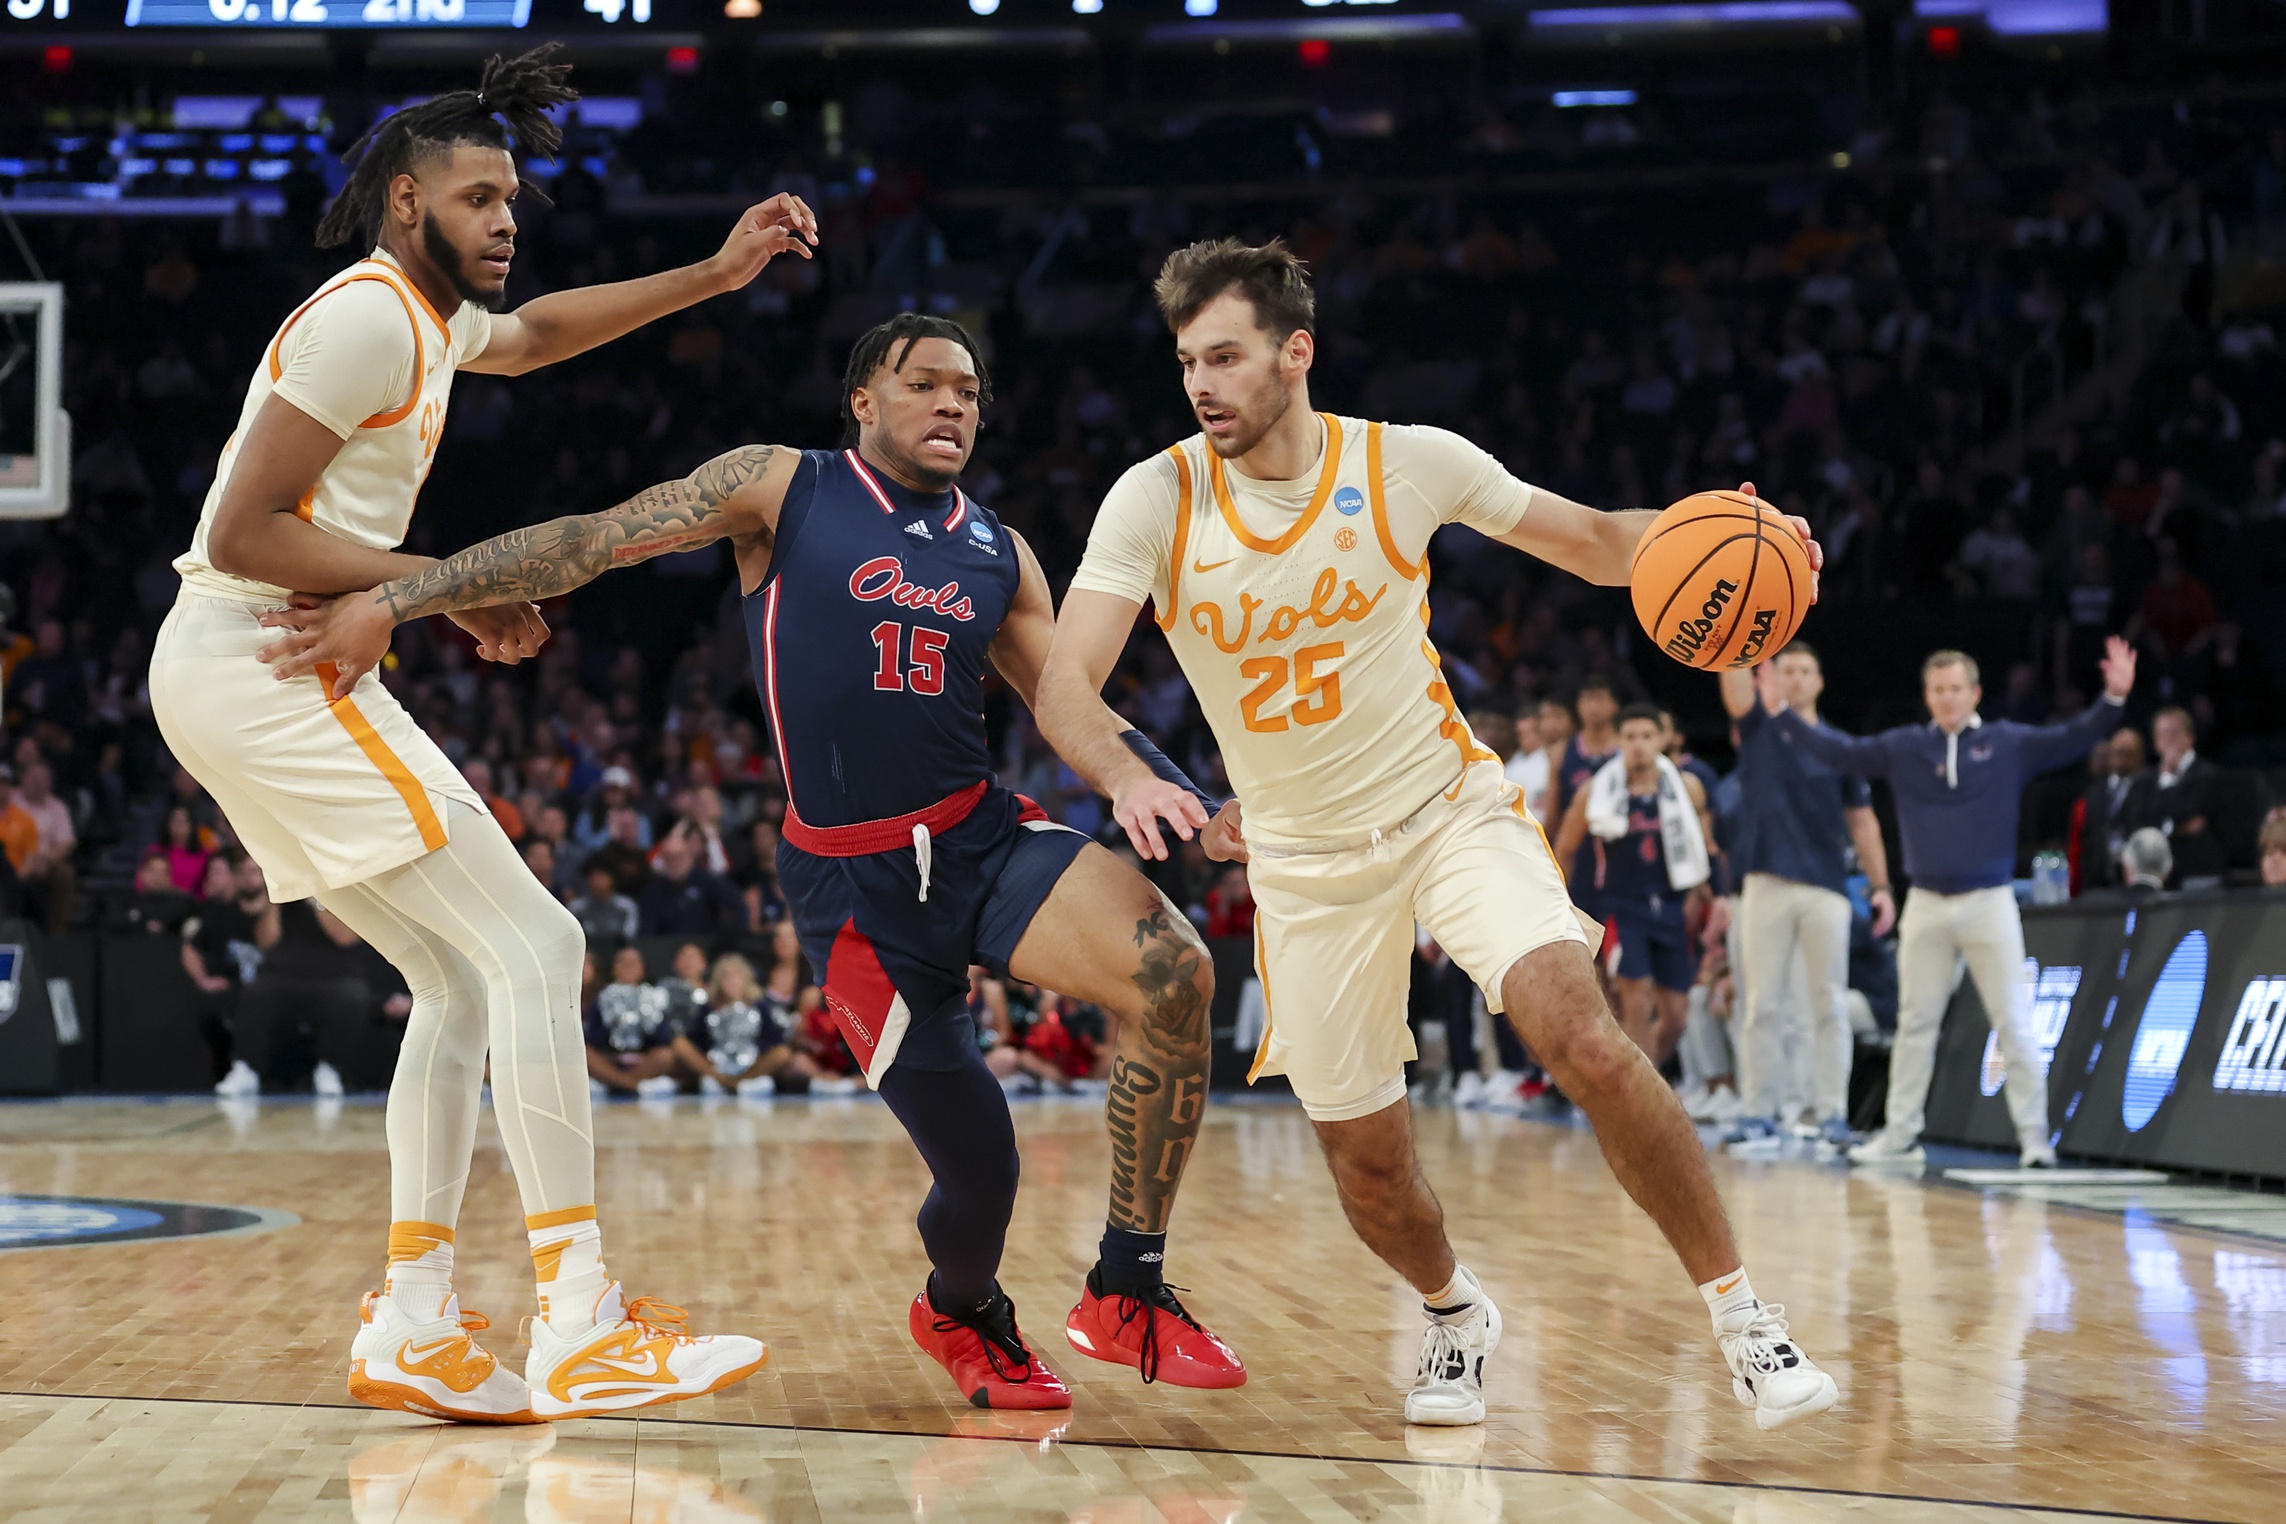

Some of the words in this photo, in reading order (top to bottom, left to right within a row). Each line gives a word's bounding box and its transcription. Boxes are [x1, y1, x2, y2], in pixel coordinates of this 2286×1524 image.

[904, 527, 933, 540] adidas
[1339, 499, 1362, 509] NCAA
[968, 538, 998, 556] C-USA
[973, 528, 993, 540] NCAA
[1337, 530, 1355, 549] SEC
[849, 556, 975, 621] Owls
[1190, 567, 1388, 654] Vols
[1665, 578, 1738, 663] Wilson
[1726, 609, 1777, 668] NCAA
[870, 620, 949, 695] 15
[1240, 641, 1345, 732] 25
